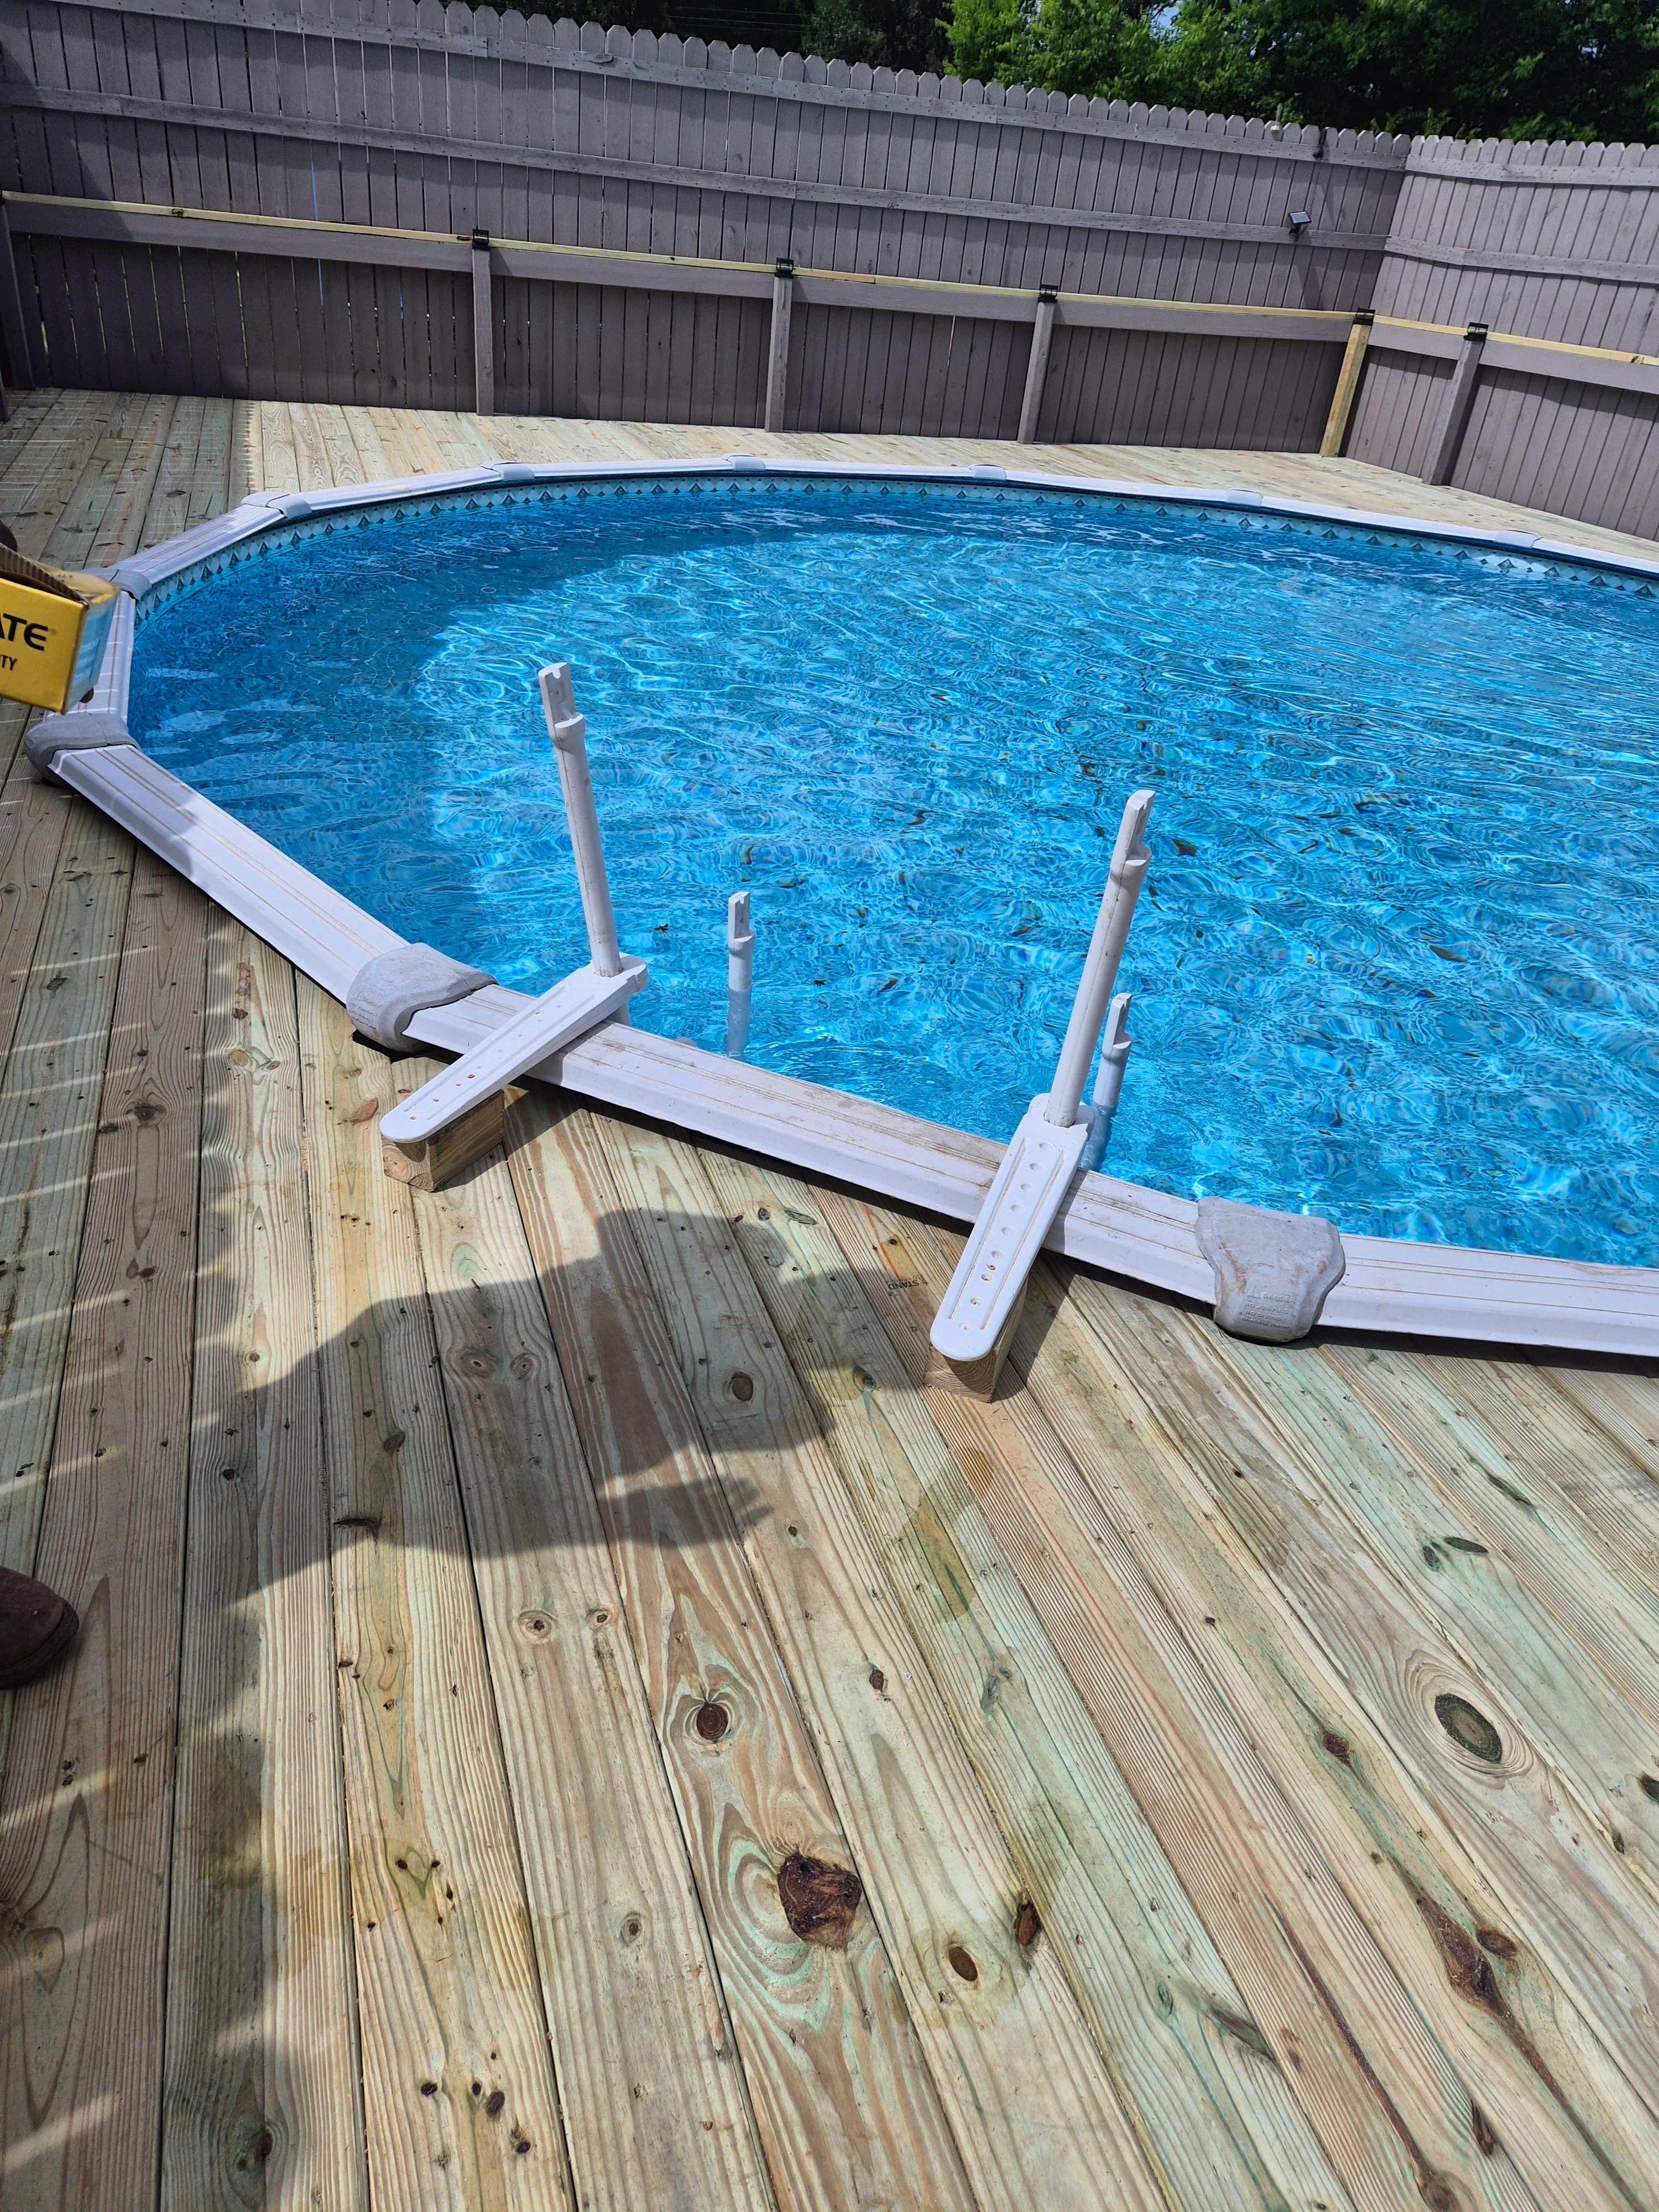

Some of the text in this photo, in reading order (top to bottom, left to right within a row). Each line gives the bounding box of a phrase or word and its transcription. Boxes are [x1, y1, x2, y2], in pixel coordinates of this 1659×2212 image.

[0, 612, 48, 651] TE
[888, 1280, 919, 1290] STAND
[1263, 1292, 1296, 1303] DANGER
[1256, 1304, 1290, 1314] JUMPING
[1256, 1312, 1284, 1321] DIVING
[1241, 1315, 1290, 1329] Shallow Water
